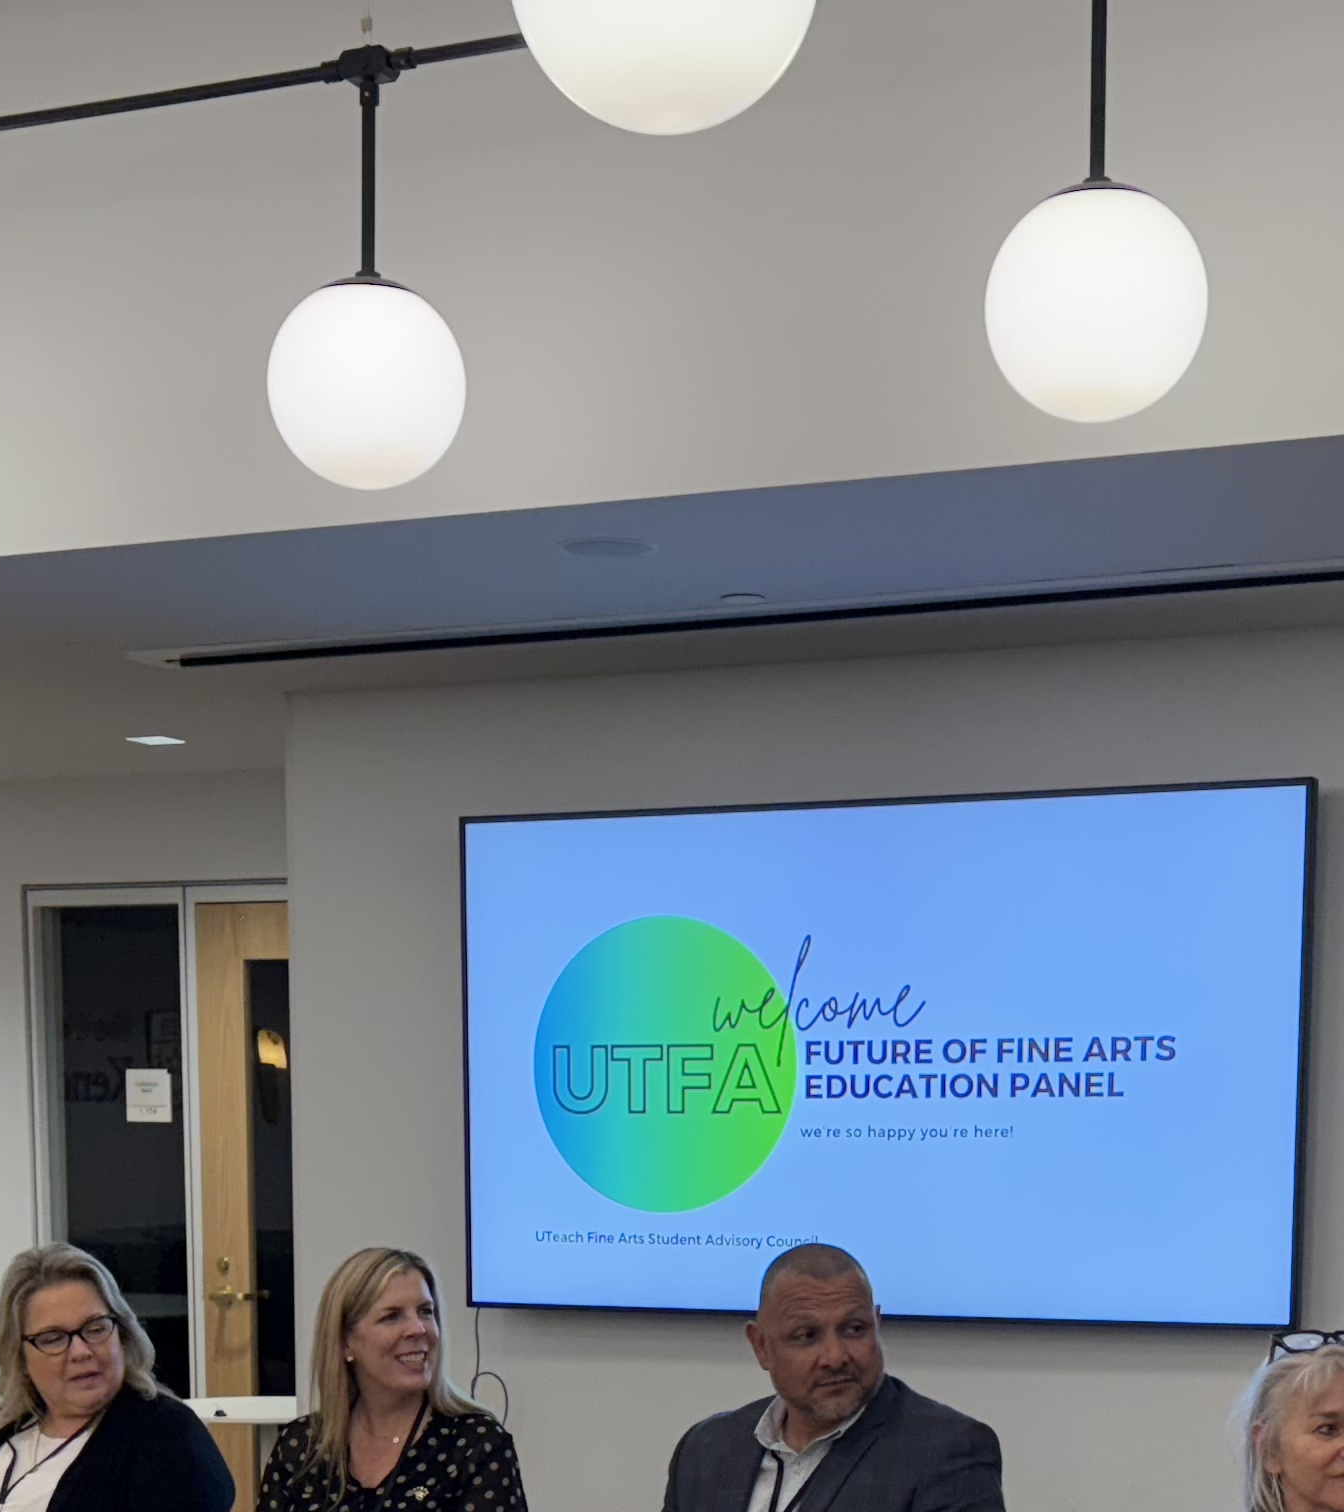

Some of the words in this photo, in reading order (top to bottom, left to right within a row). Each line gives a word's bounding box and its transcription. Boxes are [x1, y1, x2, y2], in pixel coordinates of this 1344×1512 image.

[712, 934, 926, 1067] welcome
[805, 1038, 933, 1065] FUTURE
[942, 1037, 988, 1064] OF
[996, 1036, 1074, 1063] FINE
[1082, 1035, 1177, 1062] ARTS
[551, 1042, 783, 1115] UTFA
[805, 1072, 999, 1099] EDUCATION
[1009, 1071, 1125, 1098] PANEL
[799, 1125, 841, 1138] we're
[845, 1127, 862, 1138] so
[867, 1124, 916, 1141] happy
[920, 1125, 969, 1141] you're
[974, 1124, 1014, 1138] here!
[534, 1230, 584, 1243] UTeach
[587, 1231, 615, 1244] Fine
[618, 1232, 644, 1245] Arts
[648, 1232, 701, 1246] Student
[705, 1233, 764, 1250] Advisory
